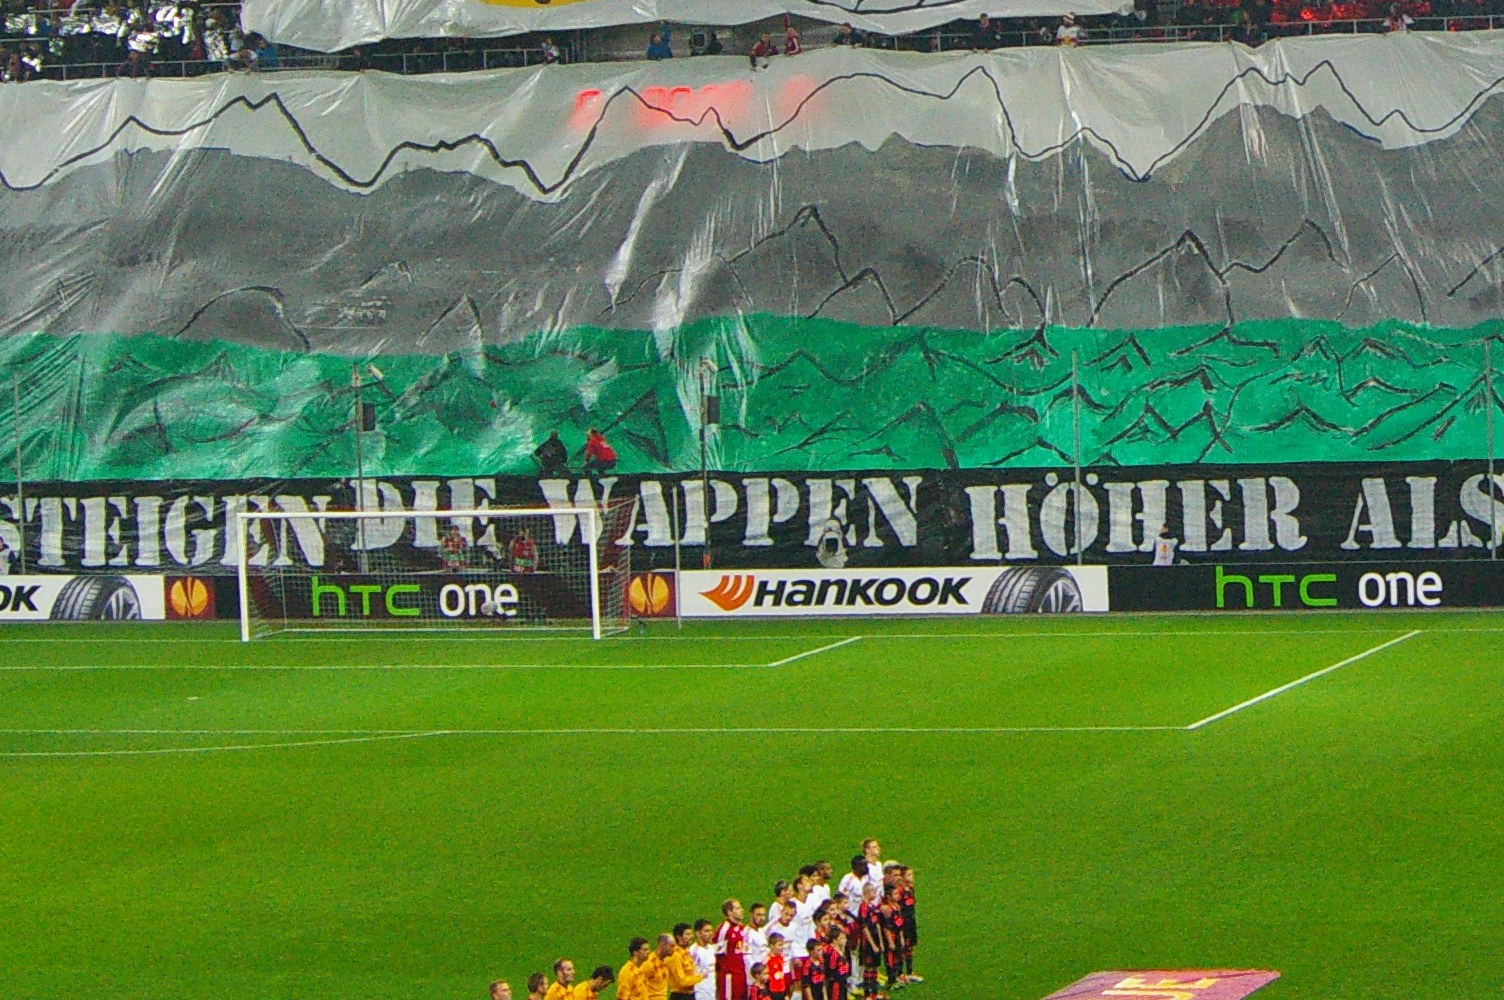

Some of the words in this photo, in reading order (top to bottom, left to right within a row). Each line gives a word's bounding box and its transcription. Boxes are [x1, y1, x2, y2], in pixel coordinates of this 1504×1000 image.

[350, 478, 496, 550] DIE
[538, 476, 923, 547] WAPPEN
[965, 473, 1308, 560] HÖHER
[439, 583, 519, 617] one
[1358, 571, 1442, 607] one
